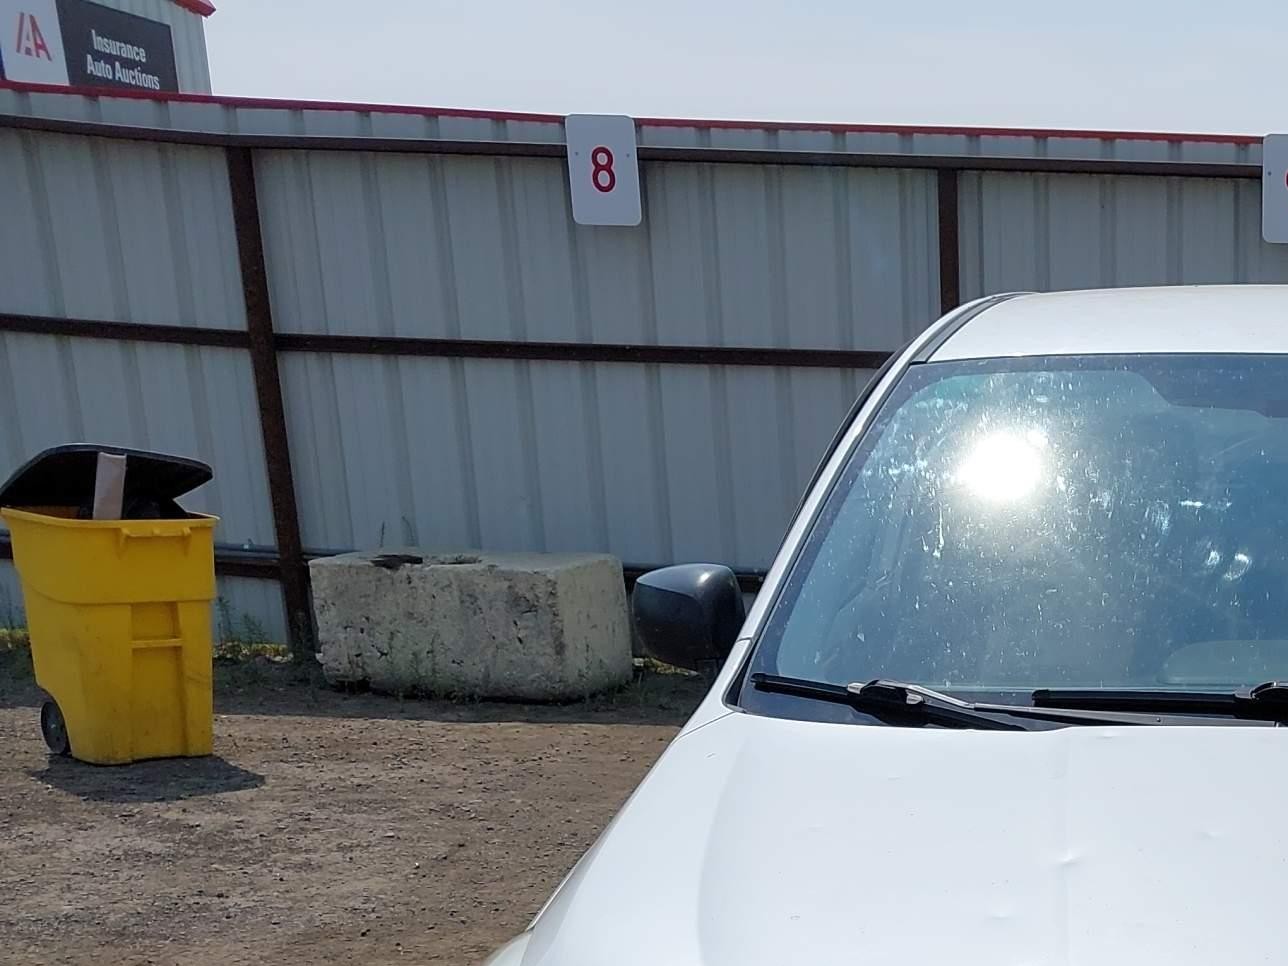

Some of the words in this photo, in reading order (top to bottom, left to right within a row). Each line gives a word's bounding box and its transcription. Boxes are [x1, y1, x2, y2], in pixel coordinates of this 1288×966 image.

[91, 29, 147, 63] Insurance
[86, 54, 113, 80] Auto
[115, 61, 160, 91] Auctions
[591, 146, 616, 193] 8
